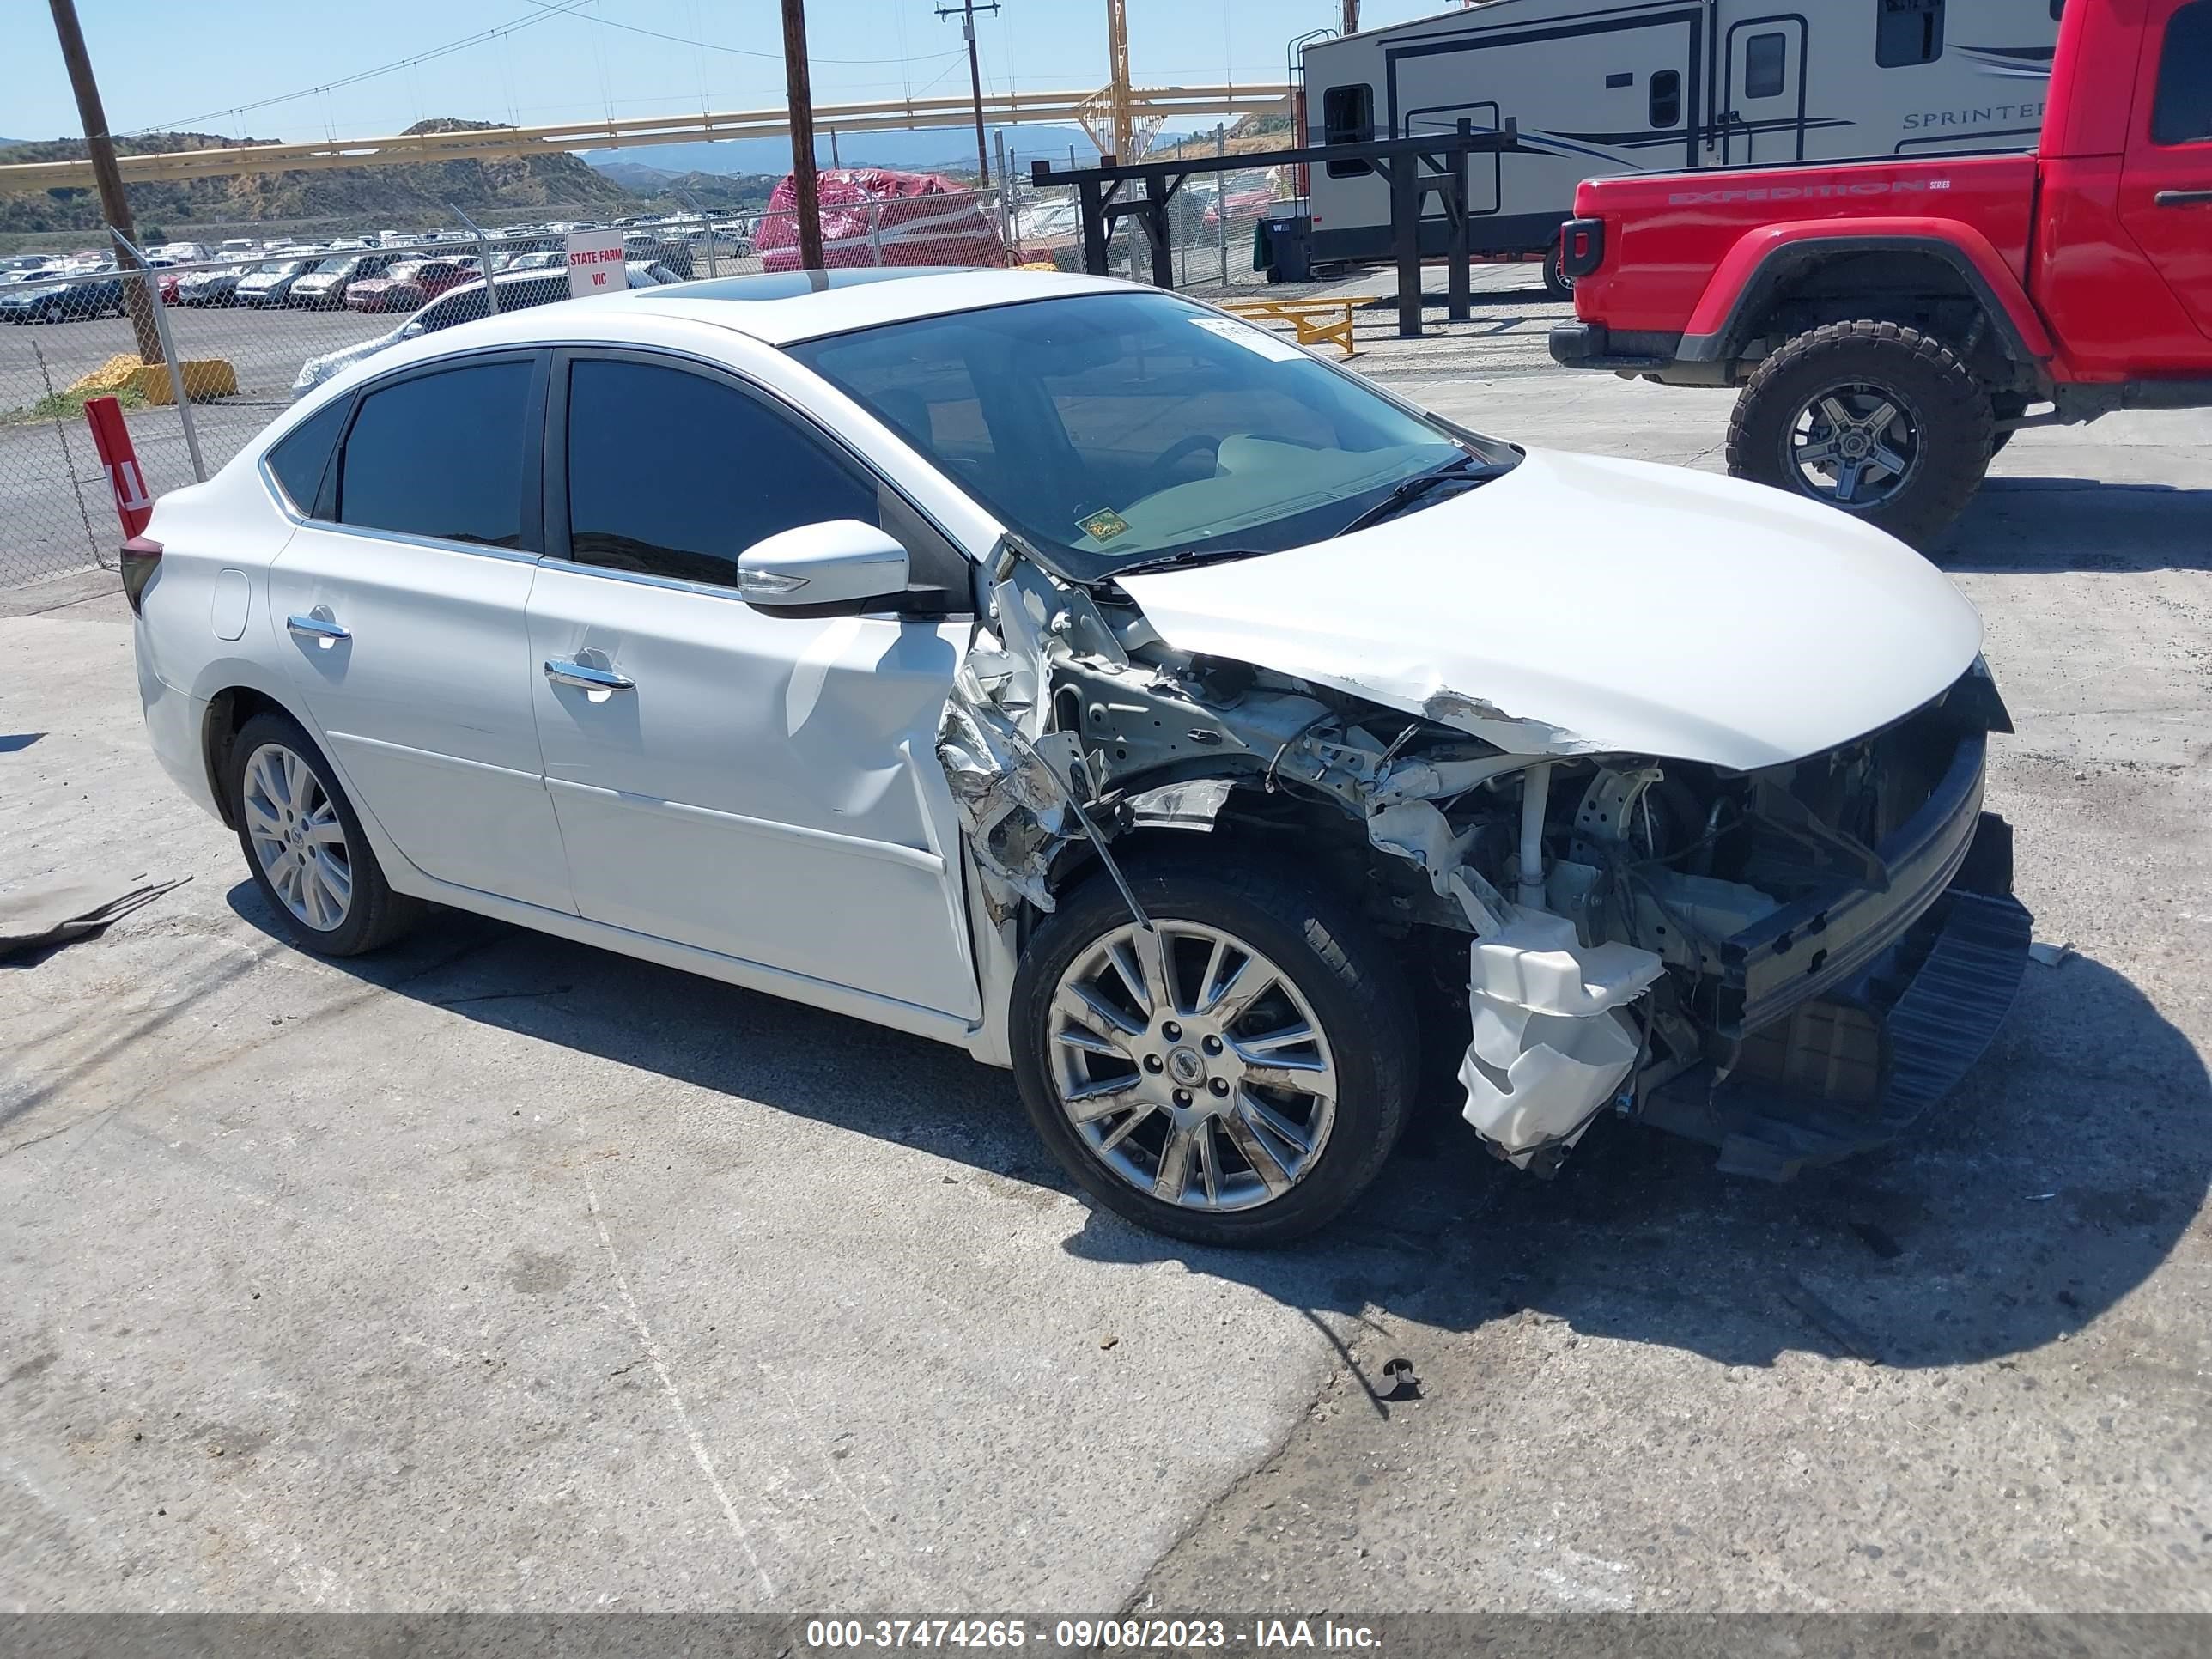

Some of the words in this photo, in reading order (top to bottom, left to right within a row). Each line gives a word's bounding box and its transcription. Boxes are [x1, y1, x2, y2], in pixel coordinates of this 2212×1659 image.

[1668, 179, 1925, 205] EXPEDITION
[1929, 180, 1951, 190] SERIES
[570, 251, 598, 266] STATE
[599, 247, 623, 263] FARM
[592, 272, 607, 286] VIC
